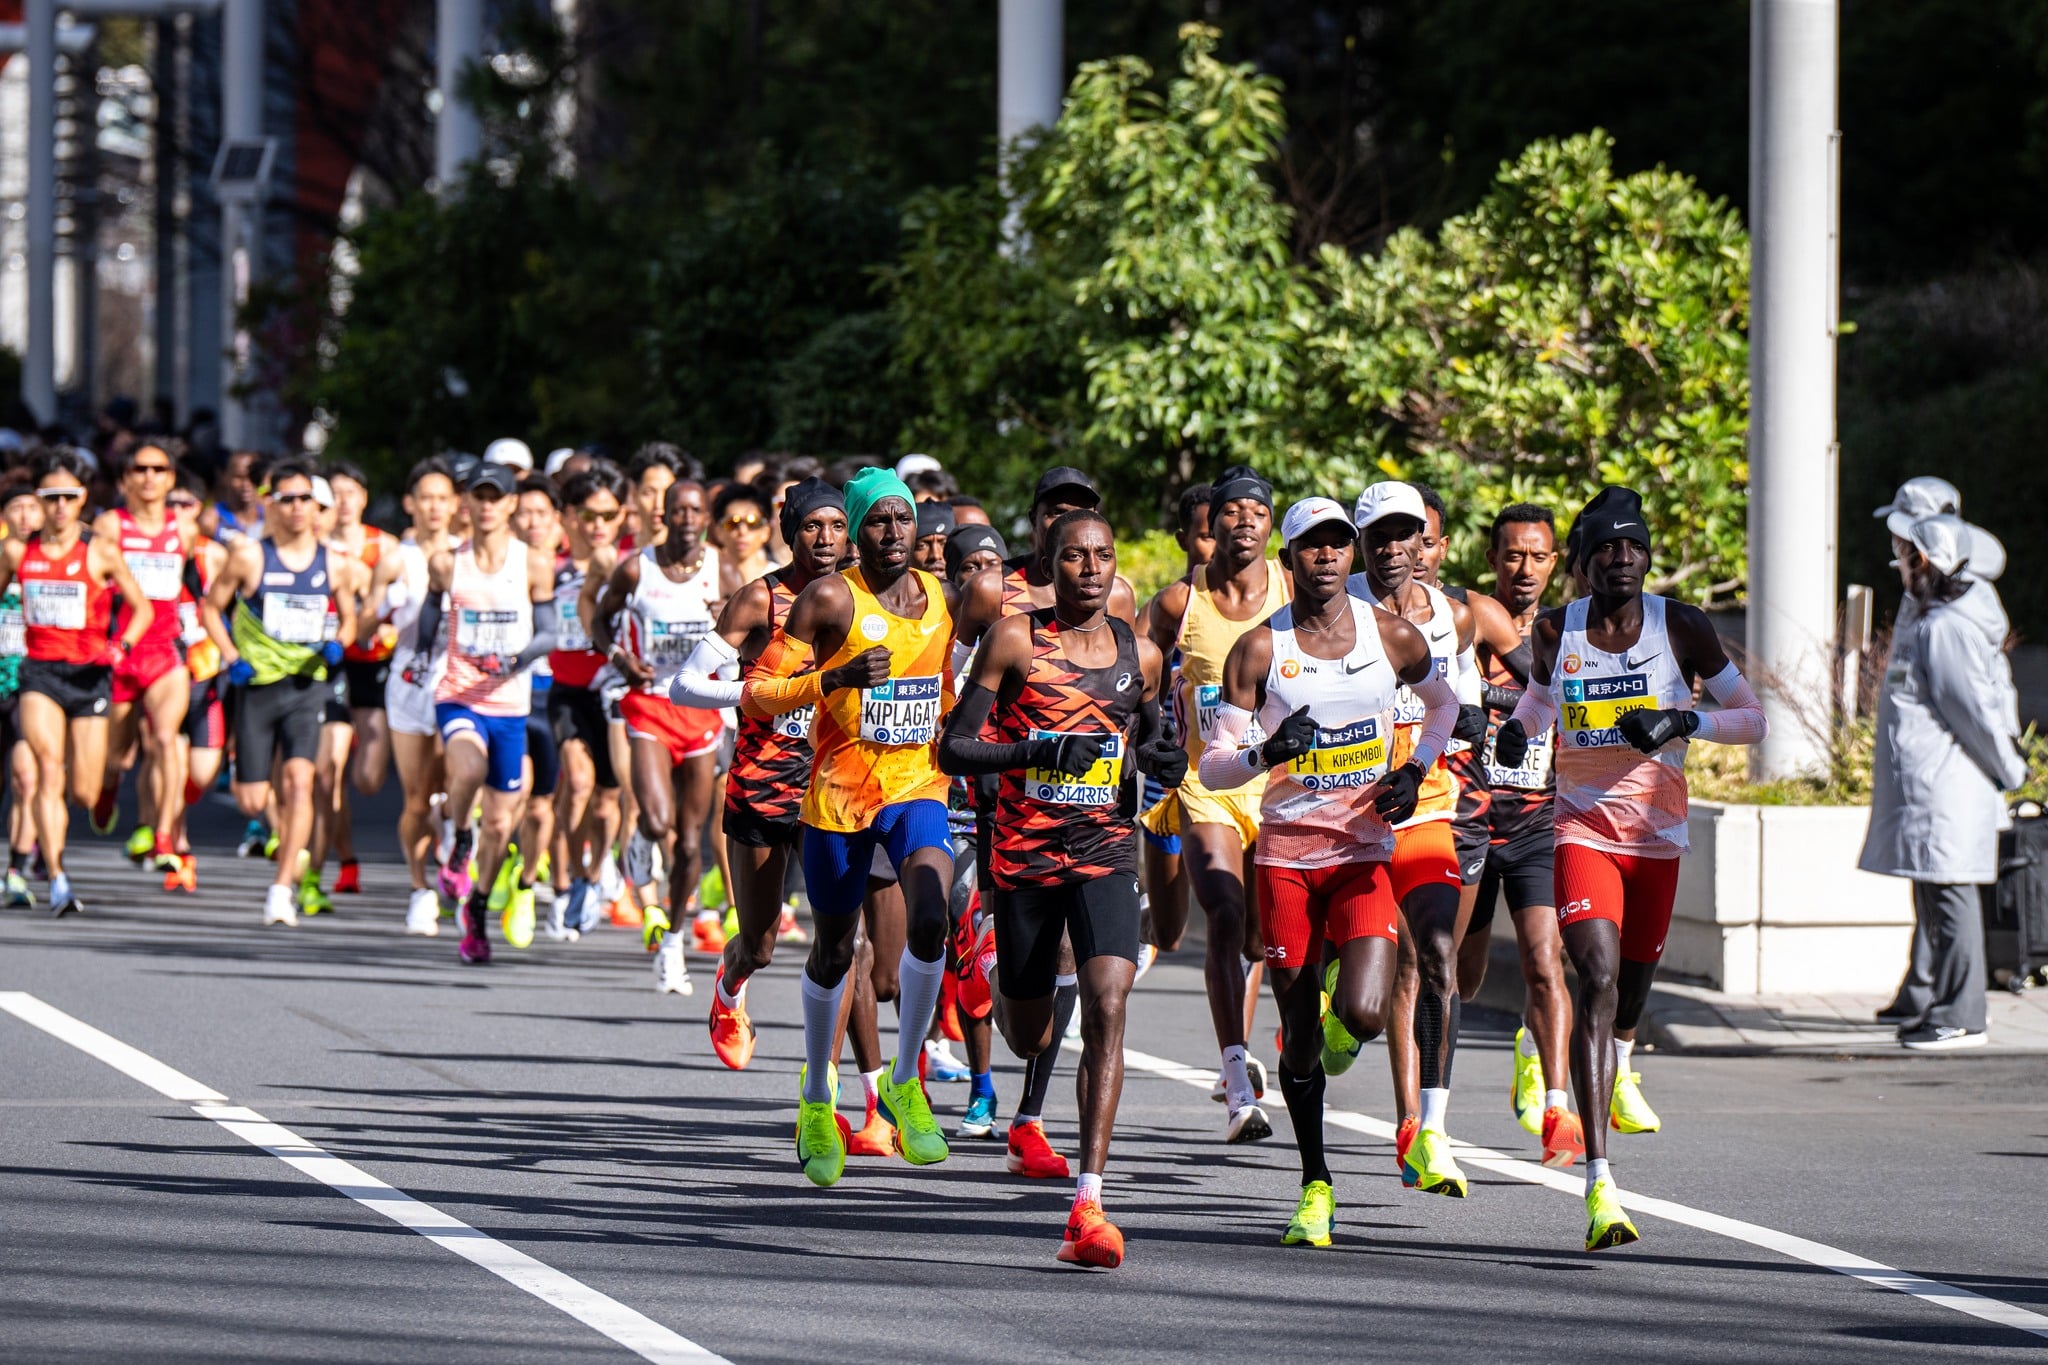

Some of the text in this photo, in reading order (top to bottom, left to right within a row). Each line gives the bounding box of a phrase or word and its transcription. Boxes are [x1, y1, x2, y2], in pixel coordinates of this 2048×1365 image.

[1303, 666, 1317, 674] NN
[897, 683, 940, 697] 東京メトロ
[1588, 680, 1643, 696] 東京メトロ
[865, 700, 937, 727] KIPLAGAT
[1402, 706, 1425, 722] STA
[1615, 704, 1645, 721] SA
[1319, 724, 1374, 745] 東京メトロ
[1332, 746, 1382, 768] KIPKEMBOI
[1101, 761, 1112, 785] 3
[1321, 768, 1376, 790] STARTS
[1055, 785, 1109, 803] STARTS
